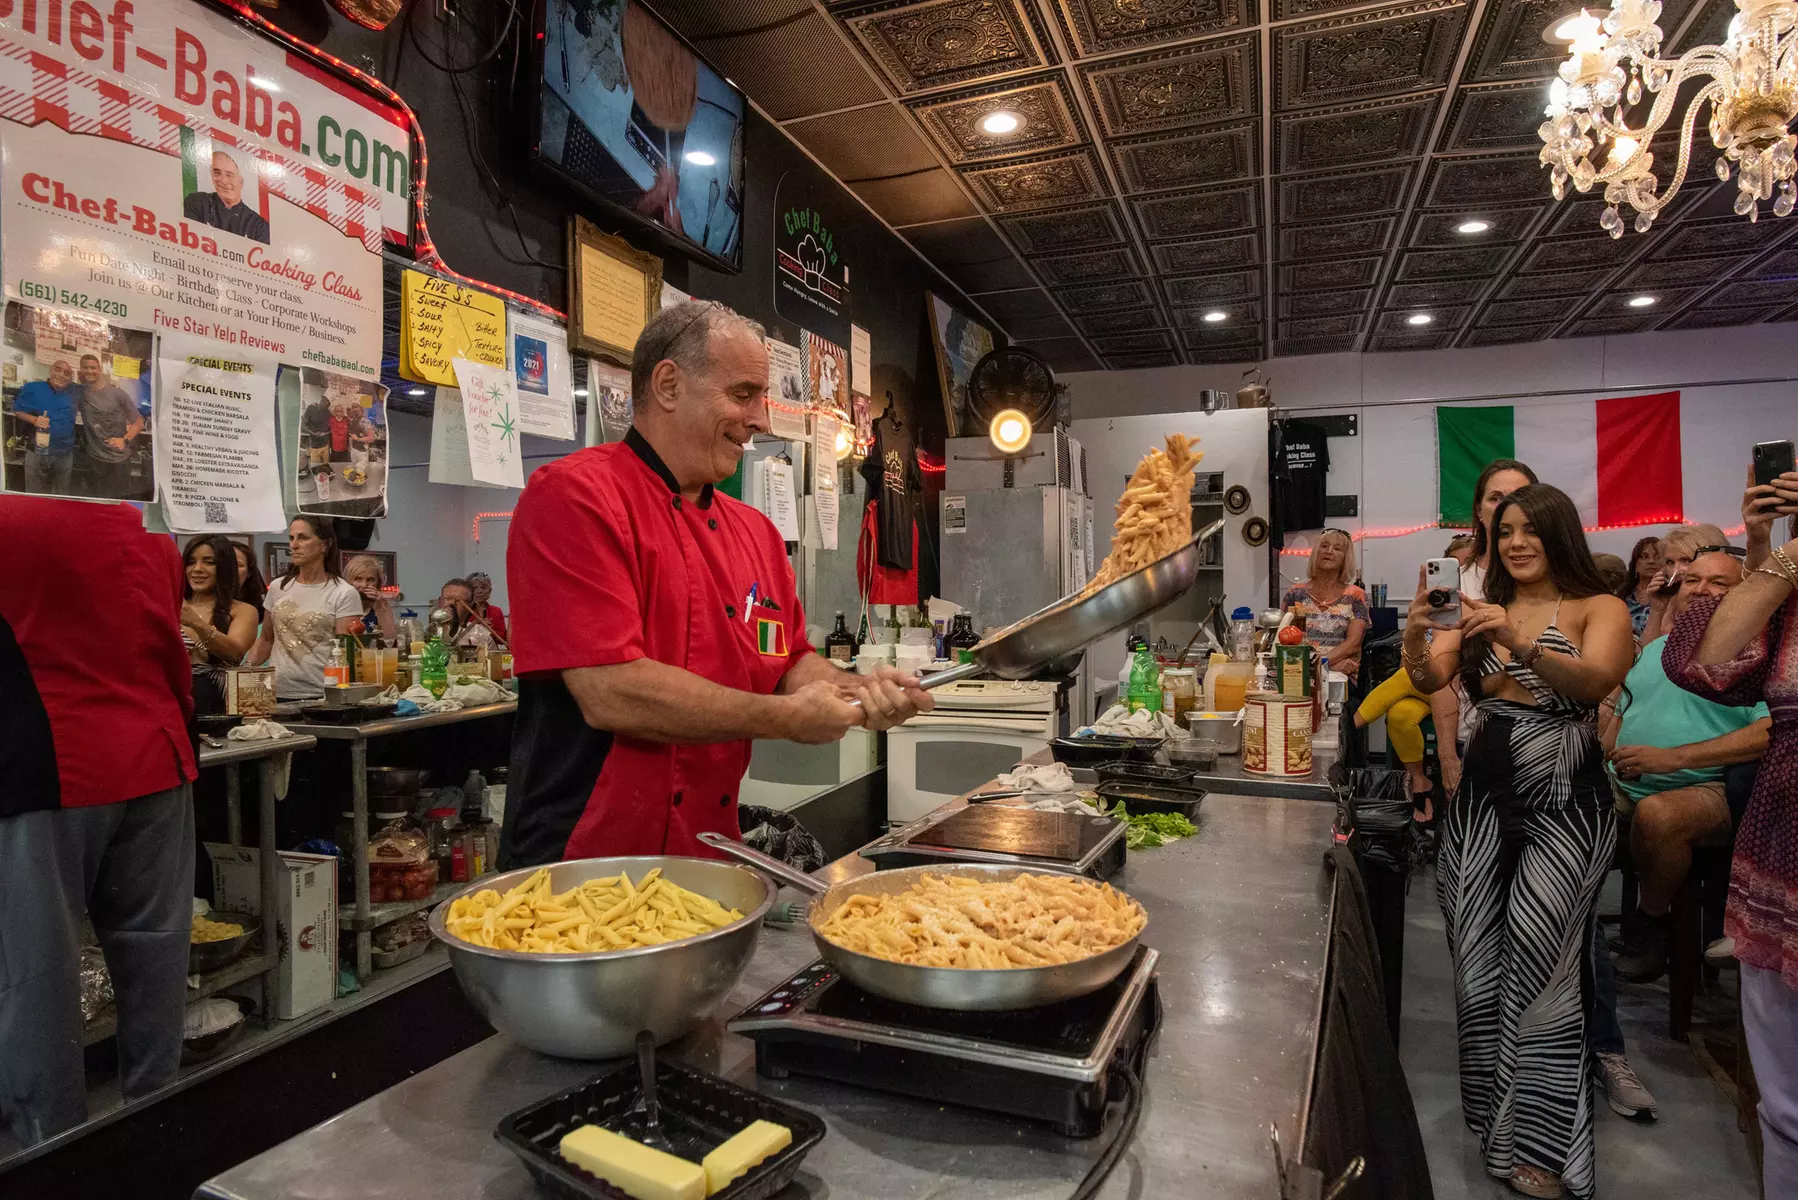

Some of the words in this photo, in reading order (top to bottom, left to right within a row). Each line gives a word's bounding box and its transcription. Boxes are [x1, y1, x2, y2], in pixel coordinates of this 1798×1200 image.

[0, 0, 408, 199] hef-Baba.com
[784, 207, 810, 236] Chef
[813, 212, 838, 266] Baba
[152, 251, 185, 271] Email
[188, 264, 200, 275] us
[202, 268, 214, 278] to
[216, 273, 253, 290] reserve
[255, 284, 278, 298] your
[280, 290, 303, 304] class.
[247, 246, 317, 291] Cooking
[322, 271, 363, 301] Class
[779, 253, 803, 277] Cooking
[822, 282, 839, 299] Class
[19, 279, 56, 304] (561)
[61, 290, 127, 317] 542-4230
[70, 245, 96, 262] Fun
[100, 253, 130, 271] Date
[132, 262, 165, 281] Night
[177, 274, 221, 299] Birthday
[226, 289, 253, 305] Class
[261, 299, 308, 321] Corporate
[310, 311, 357, 334] Workshops
[87, 268, 114, 285] Join
[118, 279, 132, 289] us
[135, 281, 148, 294] @
[151, 285, 174, 300] Our
[178, 291, 219, 312] Kitchen
[220, 306, 232, 315] or
[234, 308, 244, 318] at
[246, 310, 269, 325] Your
[272, 317, 301, 334] Home
[309, 326, 347, 345] Business.
[153, 308, 181, 331] Five
[183, 314, 210, 336] Star
[213, 323, 237, 344] Yelp
[240, 330, 286, 354] Reviews
[189, 357, 220, 369] SPECIAL
[223, 361, 252, 373] EVENTS
[302, 349, 375, 375] chefbaba@aol.com
[523, 357, 539, 371] 2021
[181, 382, 218, 395] SPECIAL
[220, 388, 252, 401] EVENTS
[201, 408, 225, 417] CHICKEN
[233, 427, 251, 435] GRAVY
[215, 446, 233, 454] VEGAN
[194, 458, 218, 466] LOBSTER
[218, 460, 259, 469] EXTRAVAGANZA
[195, 466, 226, 474] HOMEMADE
[226, 468, 249, 476] RICOTTA
[171, 485, 197, 493] TIRAMISU
